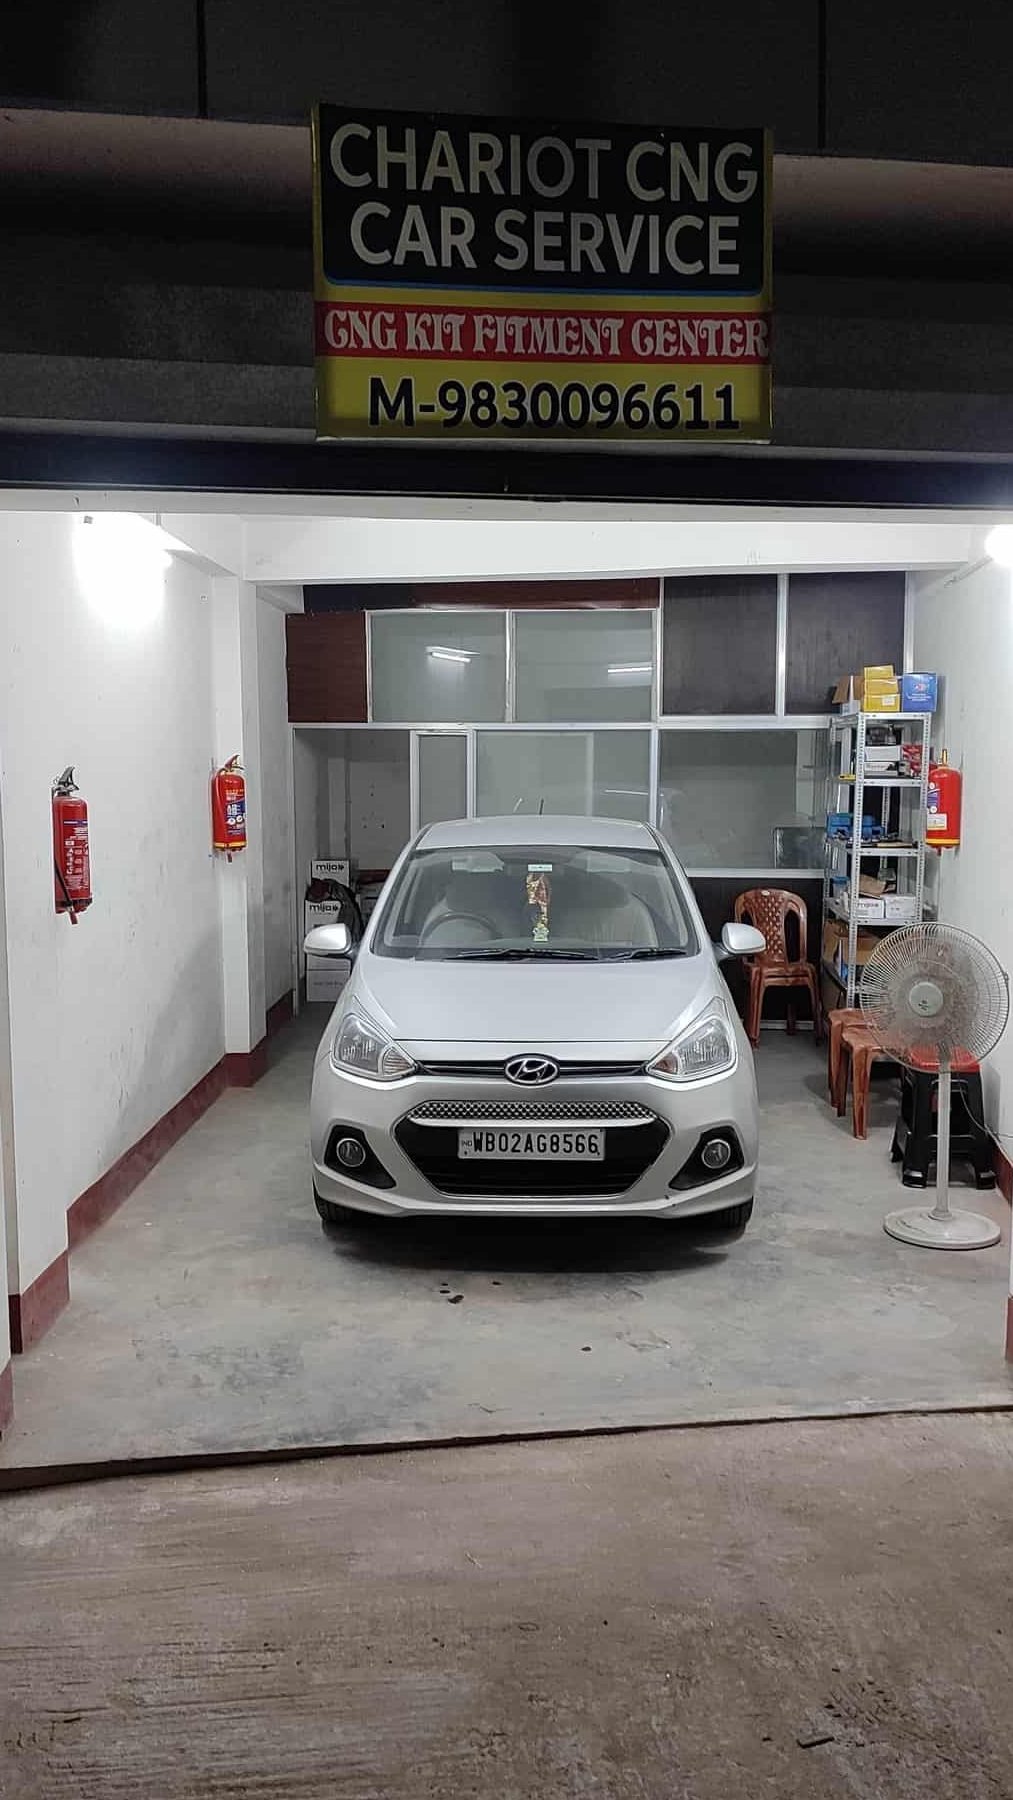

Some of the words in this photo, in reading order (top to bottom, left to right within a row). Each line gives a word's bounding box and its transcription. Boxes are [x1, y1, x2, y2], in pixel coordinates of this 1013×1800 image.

[329, 122, 611, 200] CHARIOT
[625, 140, 759, 204] CNG
[350, 201, 478, 269] CAR
[493, 208, 740, 276] SERVICE
[323, 308, 397, 350] CNG
[405, 311, 466, 352] KIT
[472, 313, 625, 357] FITMENT
[631, 317, 769, 358] CENTER
[368, 375, 740, 431] M-9830096611
[473, 1132, 599, 1154] WB02AG8566
